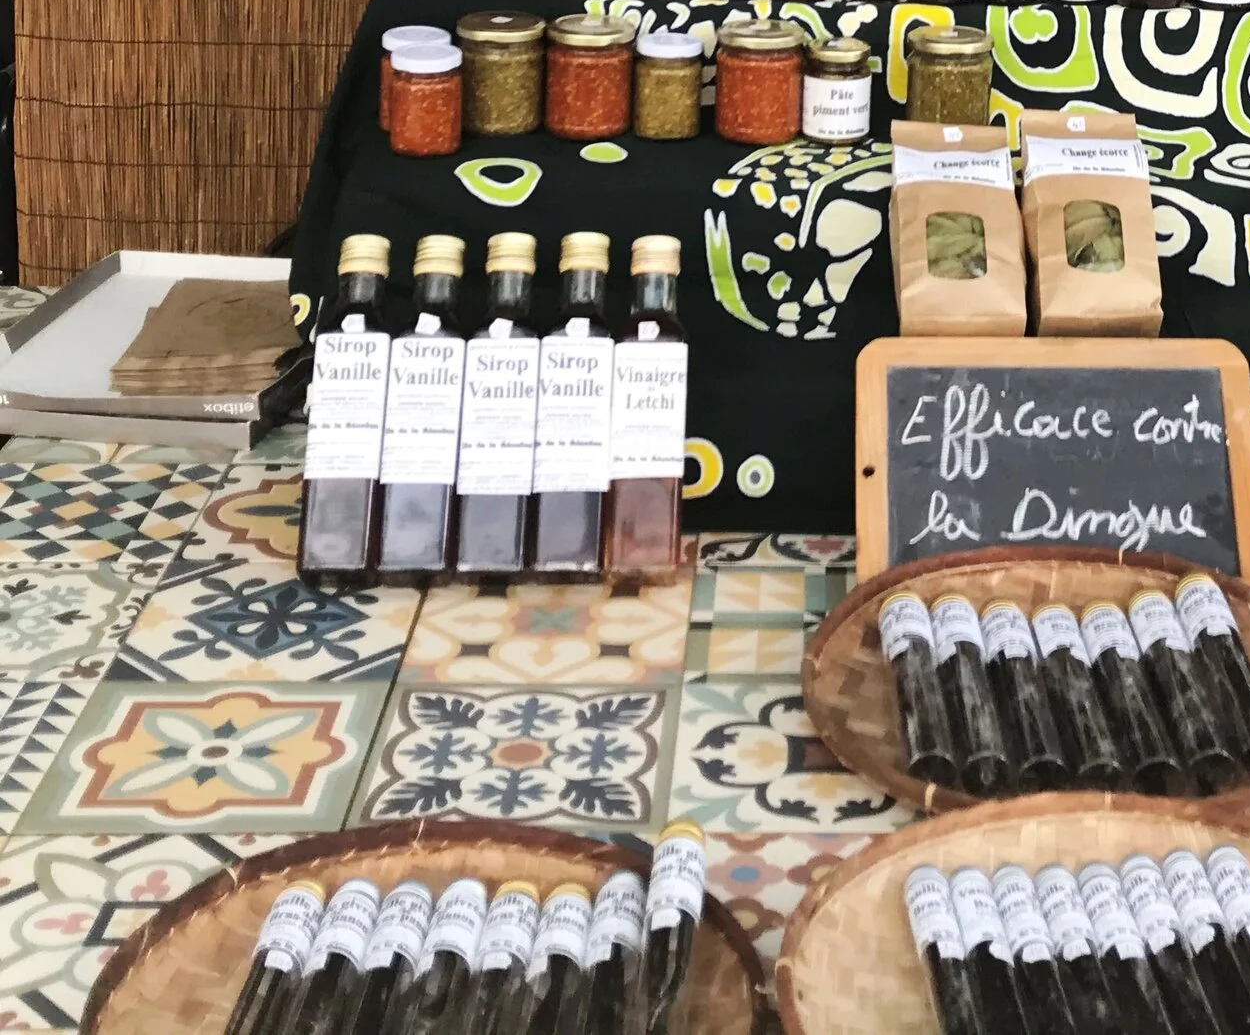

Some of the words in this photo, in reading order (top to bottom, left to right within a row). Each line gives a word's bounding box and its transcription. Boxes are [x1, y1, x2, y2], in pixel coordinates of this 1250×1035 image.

[324, 336, 377, 356] Sirop
[401, 340, 454, 363] Sirop
[316, 362, 382, 382] Vanille
[476, 354, 529, 376] Sirop
[547, 351, 599, 374] Sirop
[393, 367, 459, 386] Vanille
[616, 366, 687, 387] Vinaigre
[469, 380, 534, 399] Vanille
[539, 378, 604, 397] Vanille
[626, 393, 675, 411] Letchi
[909, 490, 981, 545] la
